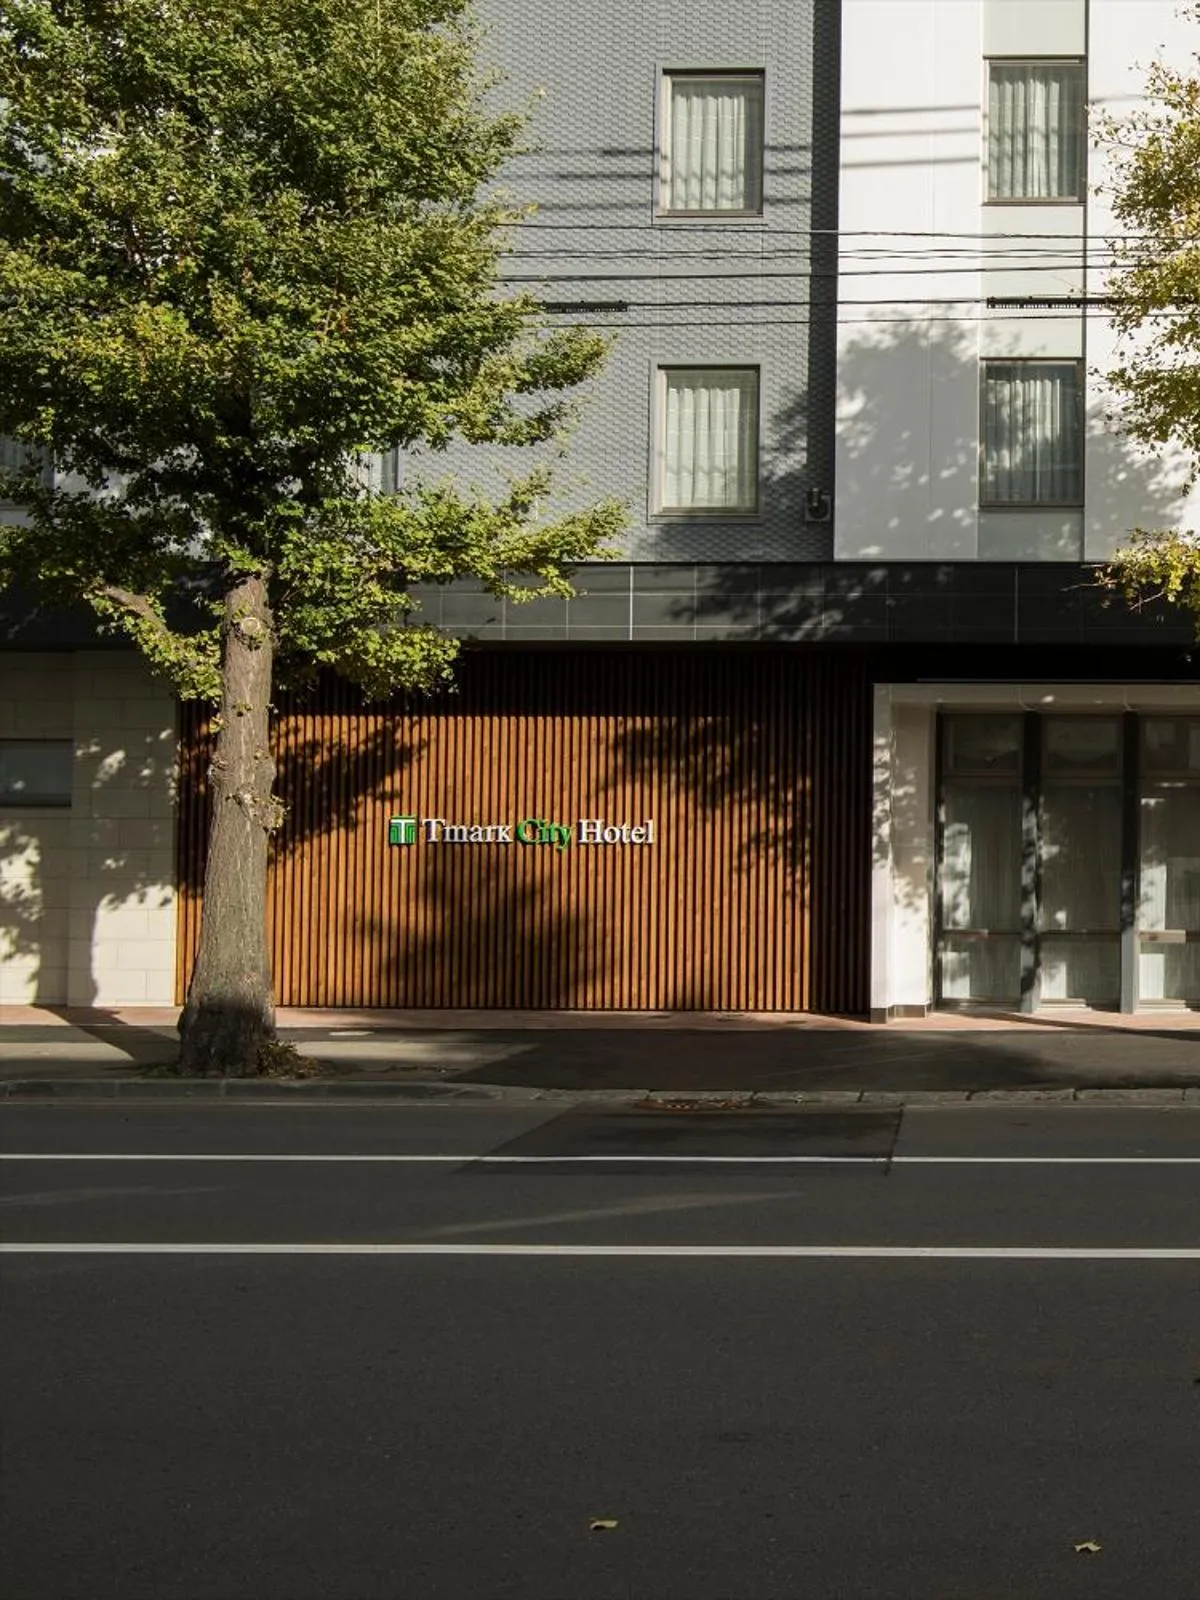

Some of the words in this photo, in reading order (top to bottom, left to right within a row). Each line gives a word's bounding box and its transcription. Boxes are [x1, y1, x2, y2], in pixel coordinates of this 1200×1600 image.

[422, 818, 513, 843] Tmark
[517, 818, 571, 850] City
[579, 818, 654, 844] Hotel
